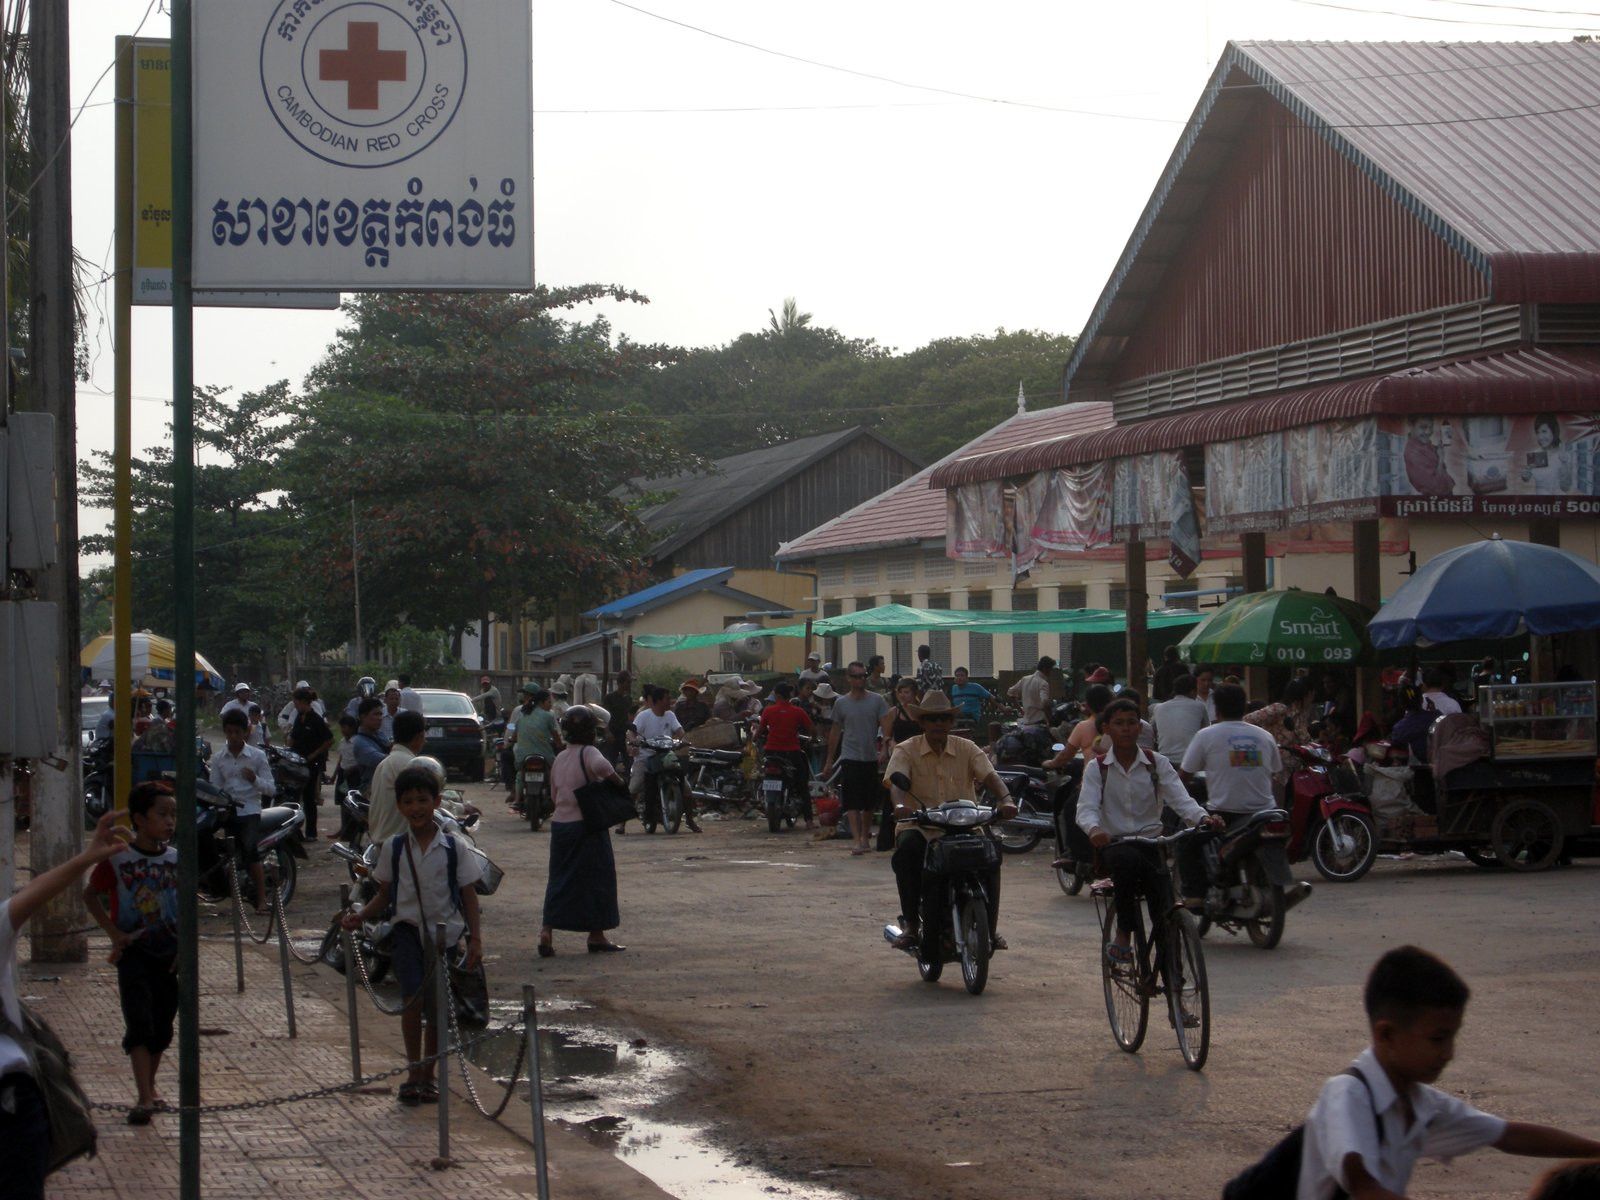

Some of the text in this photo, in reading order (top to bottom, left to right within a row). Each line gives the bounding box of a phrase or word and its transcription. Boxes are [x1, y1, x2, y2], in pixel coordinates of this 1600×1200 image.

[278, 83, 449, 152] CAMBODIAN RED CROSS
[1566, 500, 1600, 513] 500
[1280, 620, 1340, 635] Smart
[1276, 647, 1353, 660] 010 093
